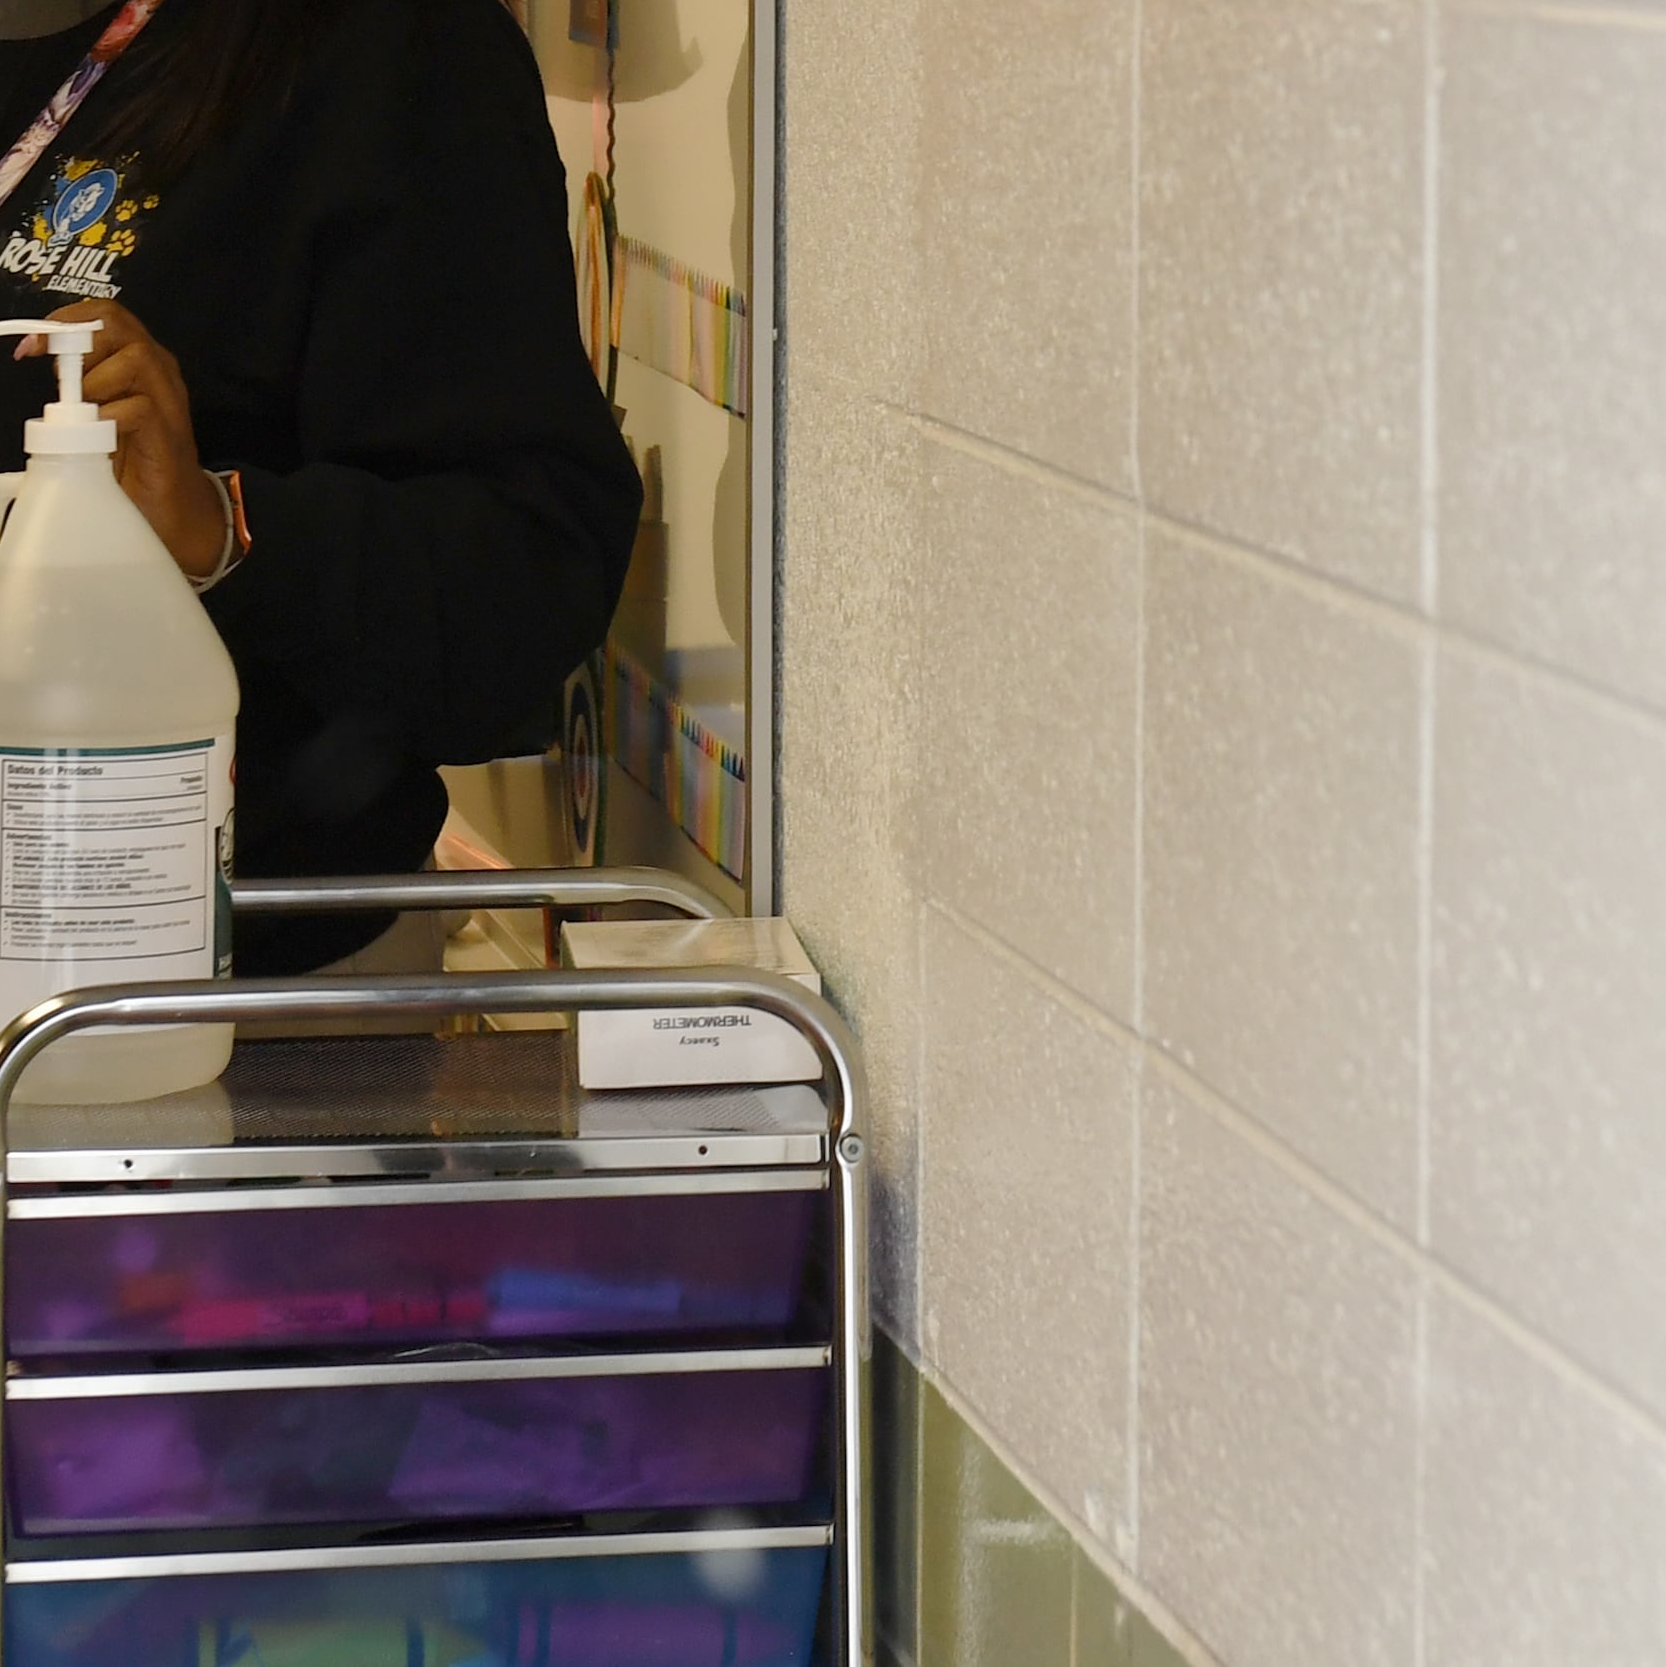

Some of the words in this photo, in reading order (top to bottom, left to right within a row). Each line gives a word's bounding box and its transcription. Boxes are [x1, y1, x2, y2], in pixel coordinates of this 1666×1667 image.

[59, 247, 120, 282] HILL
[47, 275, 122, 299] ELEMENTARY
[653, 1015, 752, 1030] THERMOMETER
